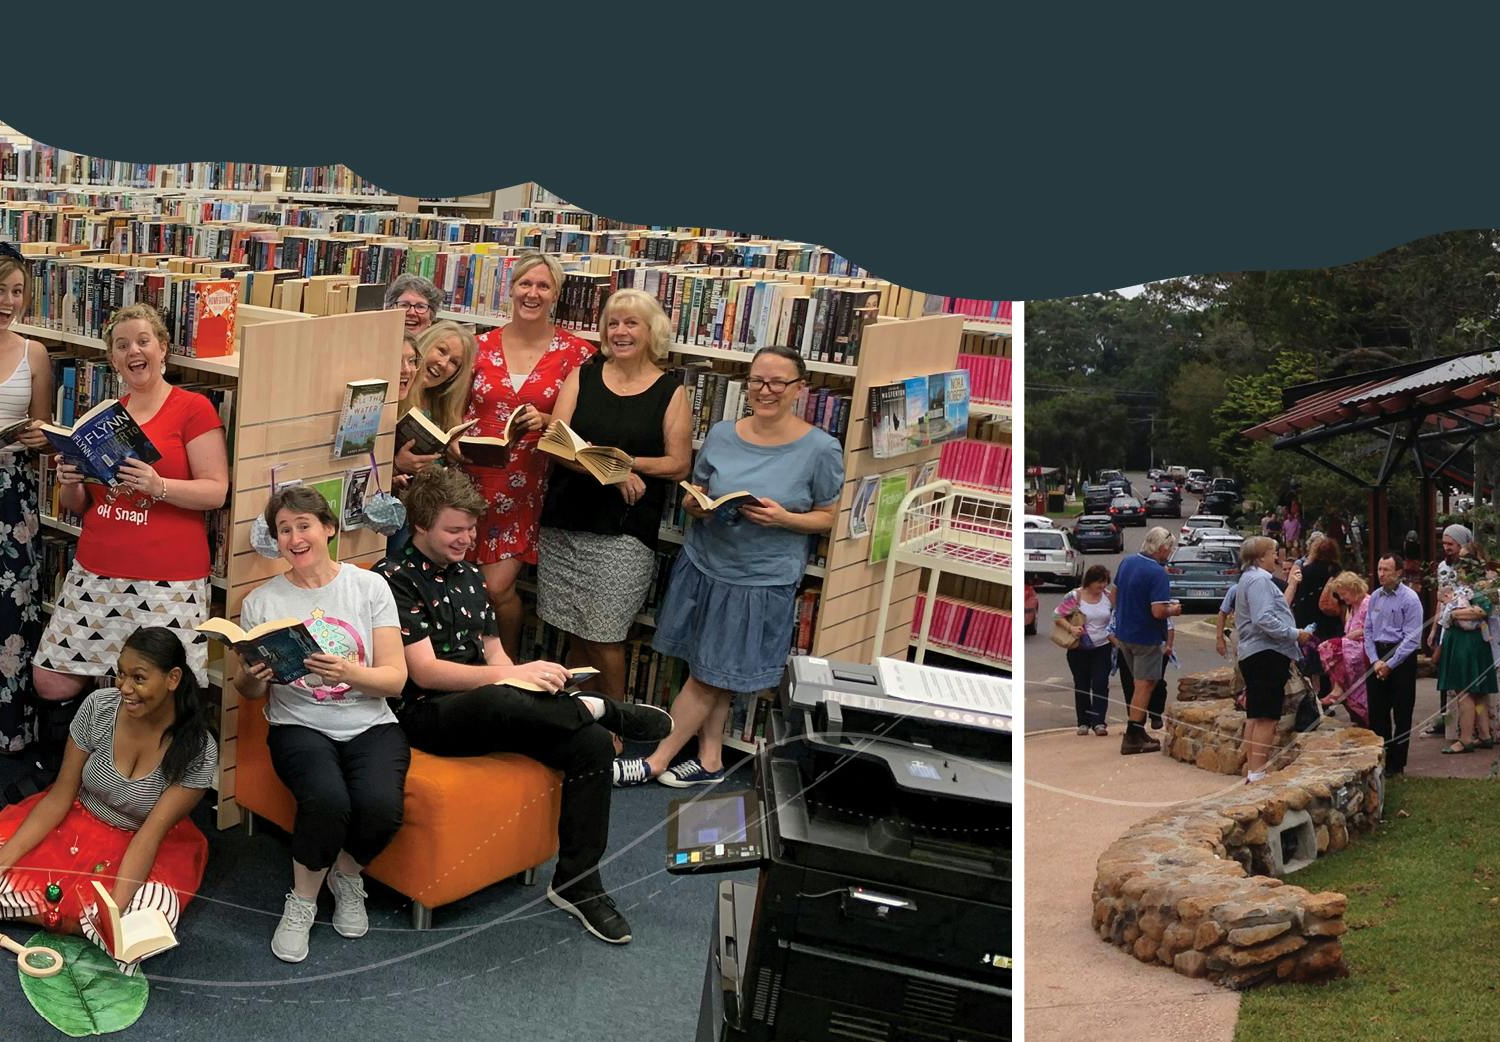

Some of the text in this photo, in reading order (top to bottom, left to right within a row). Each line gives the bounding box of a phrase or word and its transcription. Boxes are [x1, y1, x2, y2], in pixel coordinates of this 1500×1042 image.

[881, 389, 905, 399] MASTERTON
[354, 404, 378, 415] WATER
[84, 411, 130, 445] FLYNN
[72, 434, 92, 458] FLYNN
[115, 508, 148, 525] Snap!
